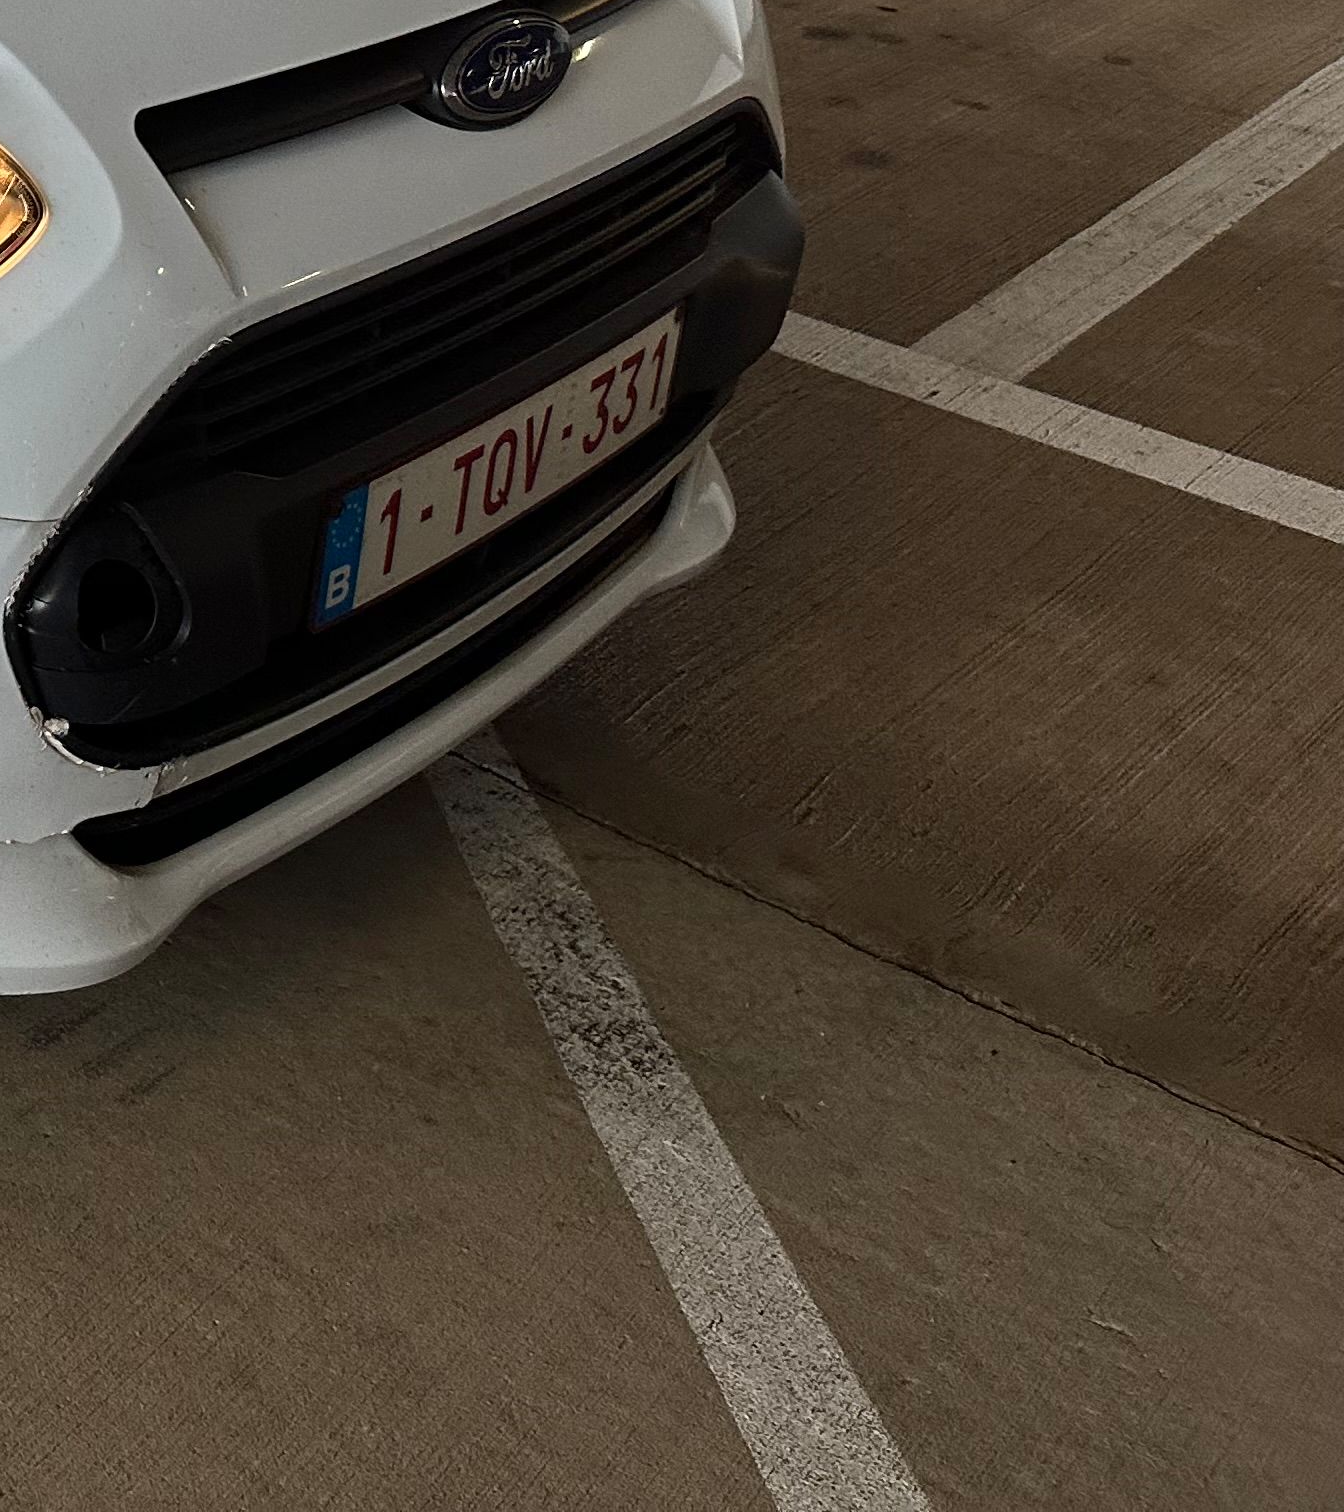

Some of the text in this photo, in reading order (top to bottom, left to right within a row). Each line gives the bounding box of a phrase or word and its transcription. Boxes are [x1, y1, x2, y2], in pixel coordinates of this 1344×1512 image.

[484, 33, 553, 99] Ford
[379, 332, 669, 576] 1-TQV-331
[324, 564, 351, 611] B
